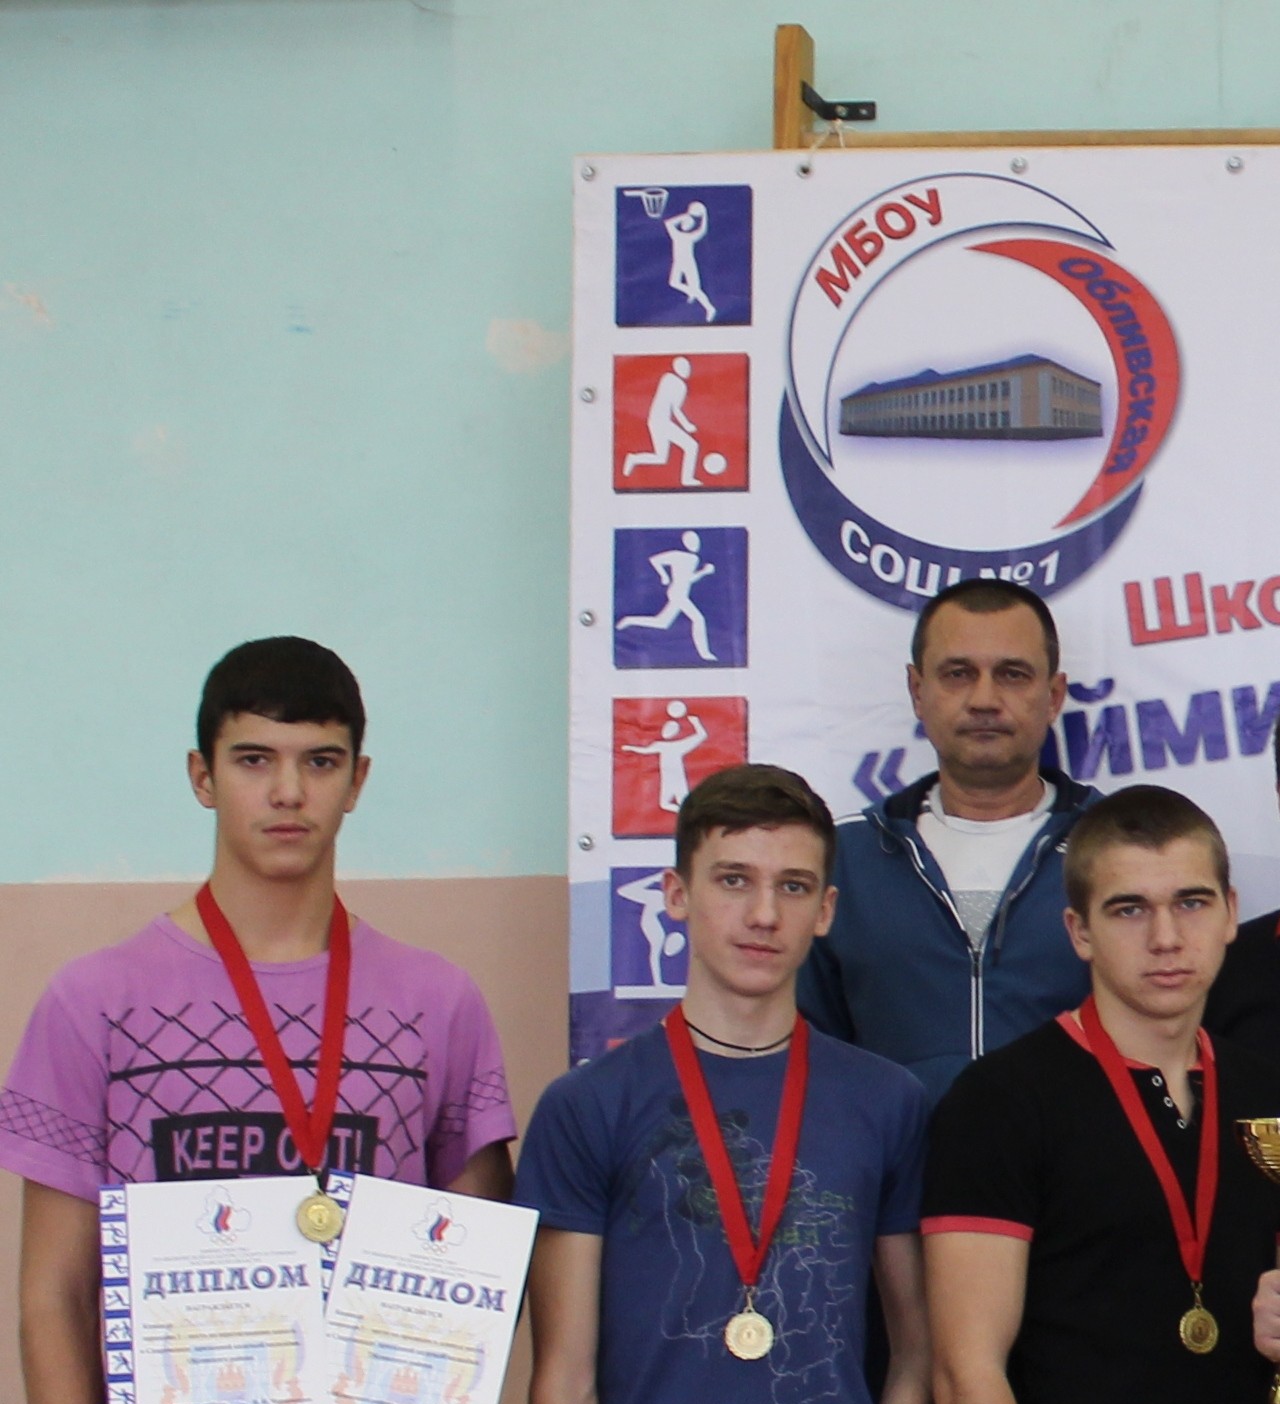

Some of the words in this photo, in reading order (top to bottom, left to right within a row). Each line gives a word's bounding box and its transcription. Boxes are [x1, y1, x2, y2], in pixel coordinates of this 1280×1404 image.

[814, 187, 945, 309] МБОУ
[1058, 257, 1157, 475] Обливская
[172, 1125, 265, 1174] KEEP
[277, 1126, 363, 1172] OT!
[143, 1263, 310, 1300] ДИПЛОМ
[343, 1261, 507, 1313] ДИПЛОМ
